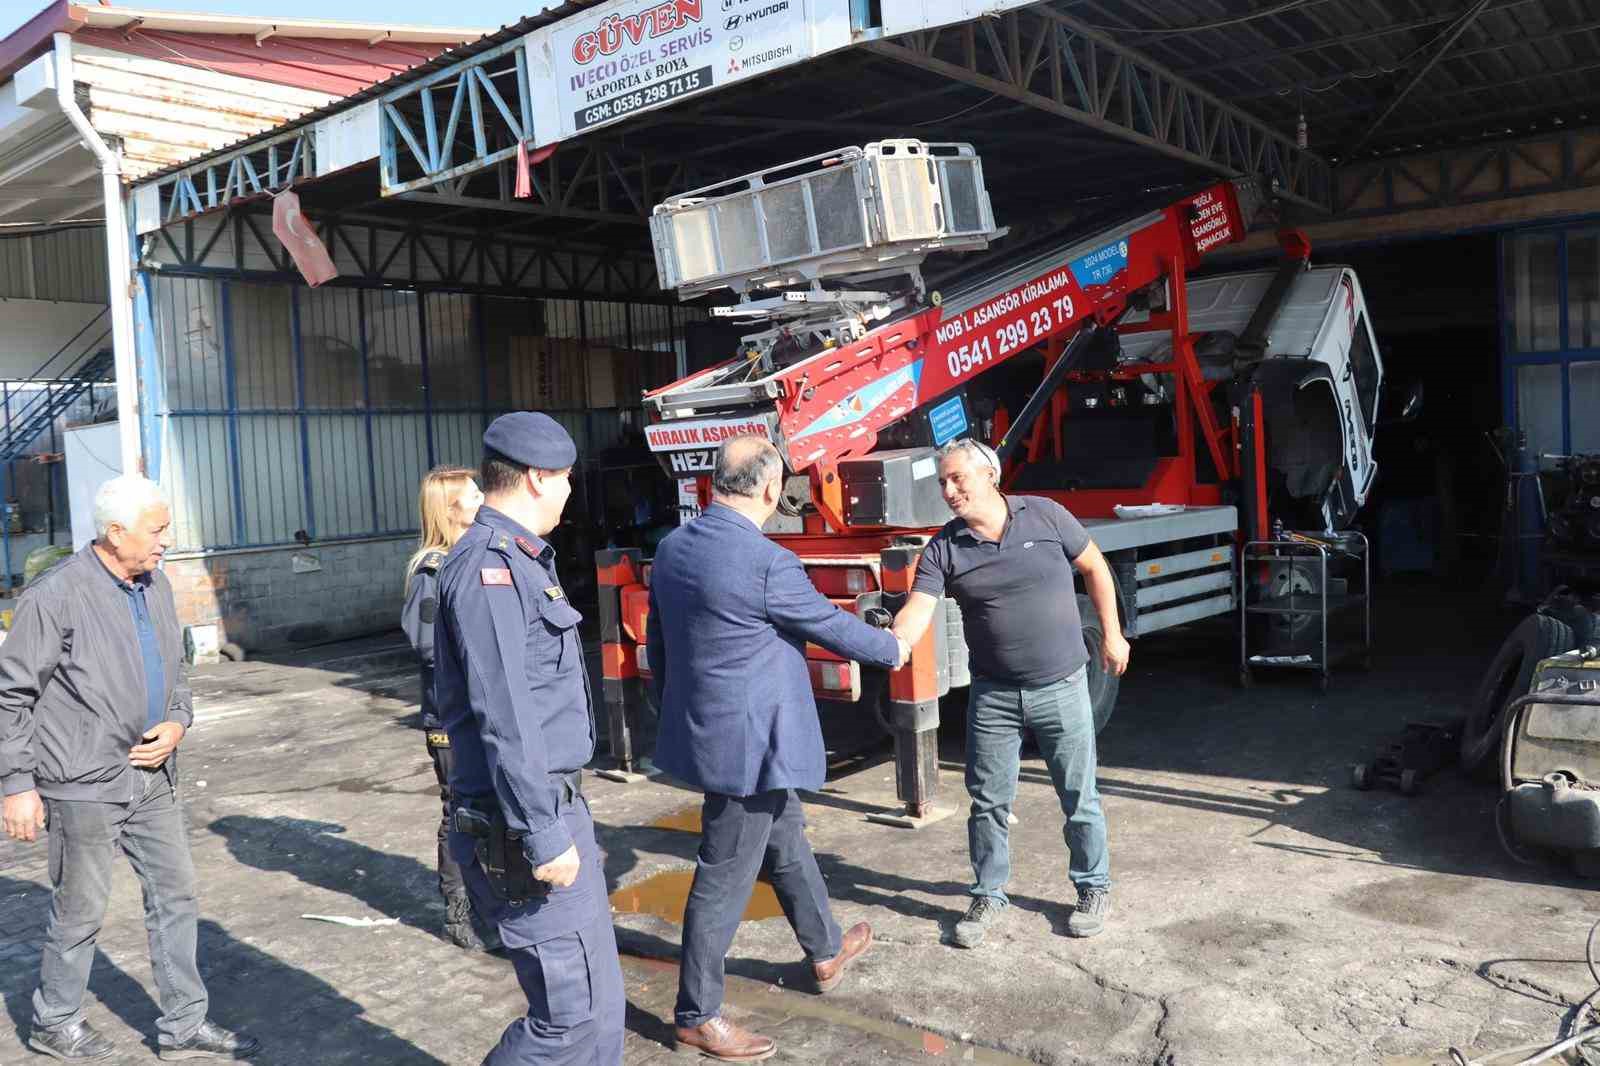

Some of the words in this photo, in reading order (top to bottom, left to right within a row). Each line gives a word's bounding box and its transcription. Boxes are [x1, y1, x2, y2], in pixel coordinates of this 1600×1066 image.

[572, 0, 702, 64] GÜVEN
[745, 1, 789, 22] HYUNDAI
[571, 61, 617, 91] IVECO
[619, 52, 655, 73] ÖZEL
[660, 27, 713, 59] SERVİS
[586, 73, 641, 102] KAPORTA
[643, 70, 653, 83] &
[655, 57, 689, 79] BOYA
[742, 45, 792, 69] MITSUBISHI
[585, 106, 612, 123] GSM:
[613, 94, 642, 113] 0536
[644, 86, 667, 105] 298
[671, 80, 684, 96] 71
[685, 73, 700, 91] 15
[936, 319, 973, 345] MOBL
[972, 290, 1021, 328] ASANSÖR
[1021, 271, 1069, 305] KİRALAMA
[947, 335, 993, 378] 0541
[996, 319, 1028, 352] 299
[1033, 306, 1052, 336] 23
[1052, 295, 1073, 322] 79
[649, 428, 700, 446] KİRALIK
[702, 421, 768, 442] ASANSÖR
